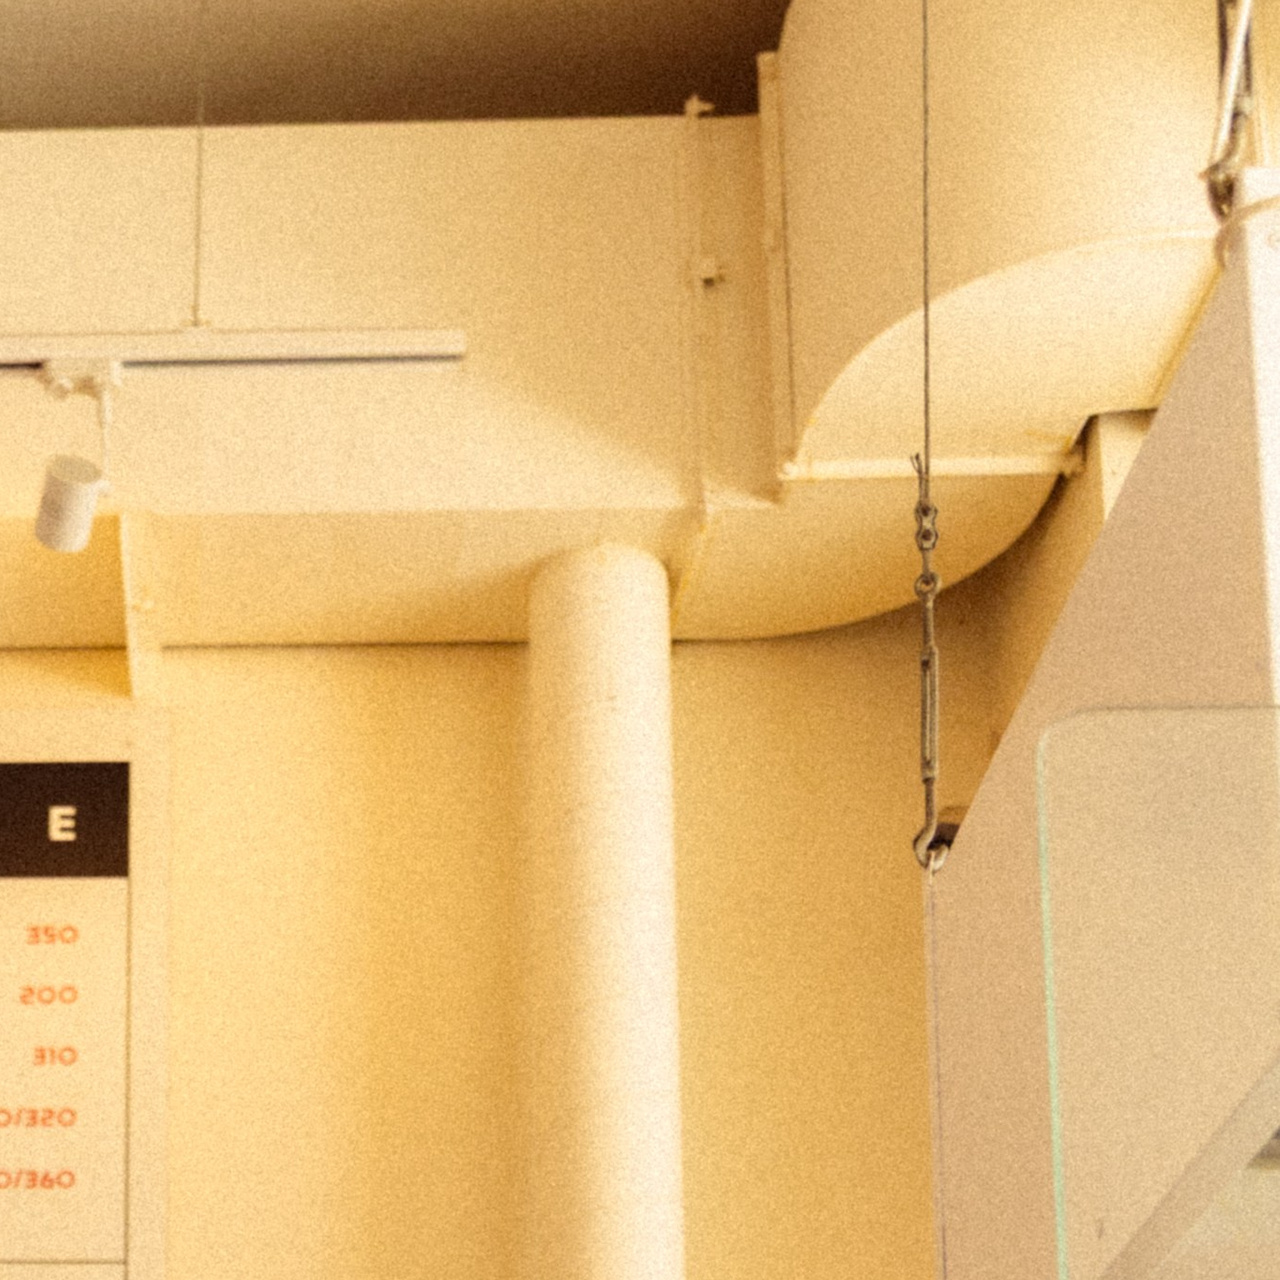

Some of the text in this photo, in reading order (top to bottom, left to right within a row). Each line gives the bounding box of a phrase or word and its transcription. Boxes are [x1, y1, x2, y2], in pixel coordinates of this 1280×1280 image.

[27, 924, 80, 946] 350
[19, 984, 80, 1006] 200
[34, 1045, 80, 1067] 310
